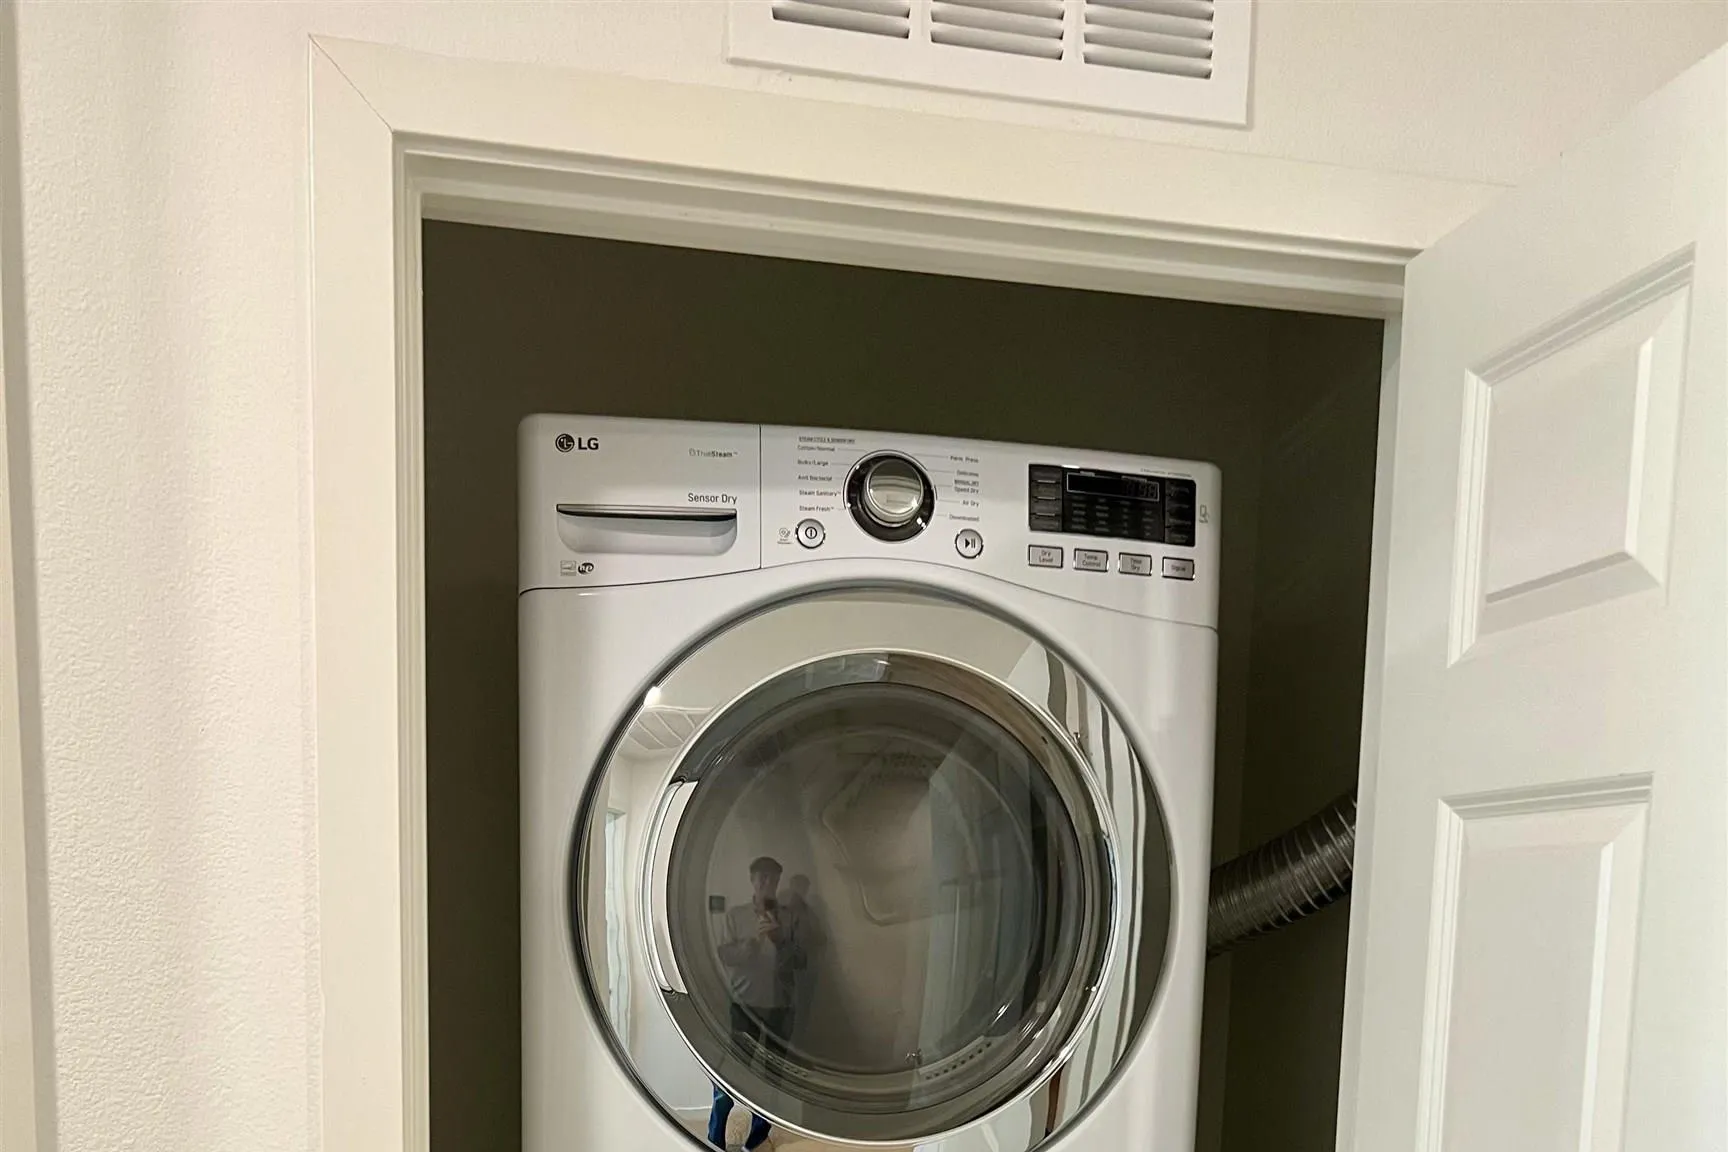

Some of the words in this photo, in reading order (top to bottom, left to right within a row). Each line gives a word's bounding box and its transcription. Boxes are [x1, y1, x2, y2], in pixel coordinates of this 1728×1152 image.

[577, 437, 599, 450] LG
[687, 492, 720, 504] Sensor
[721, 493, 738, 505] Dry
